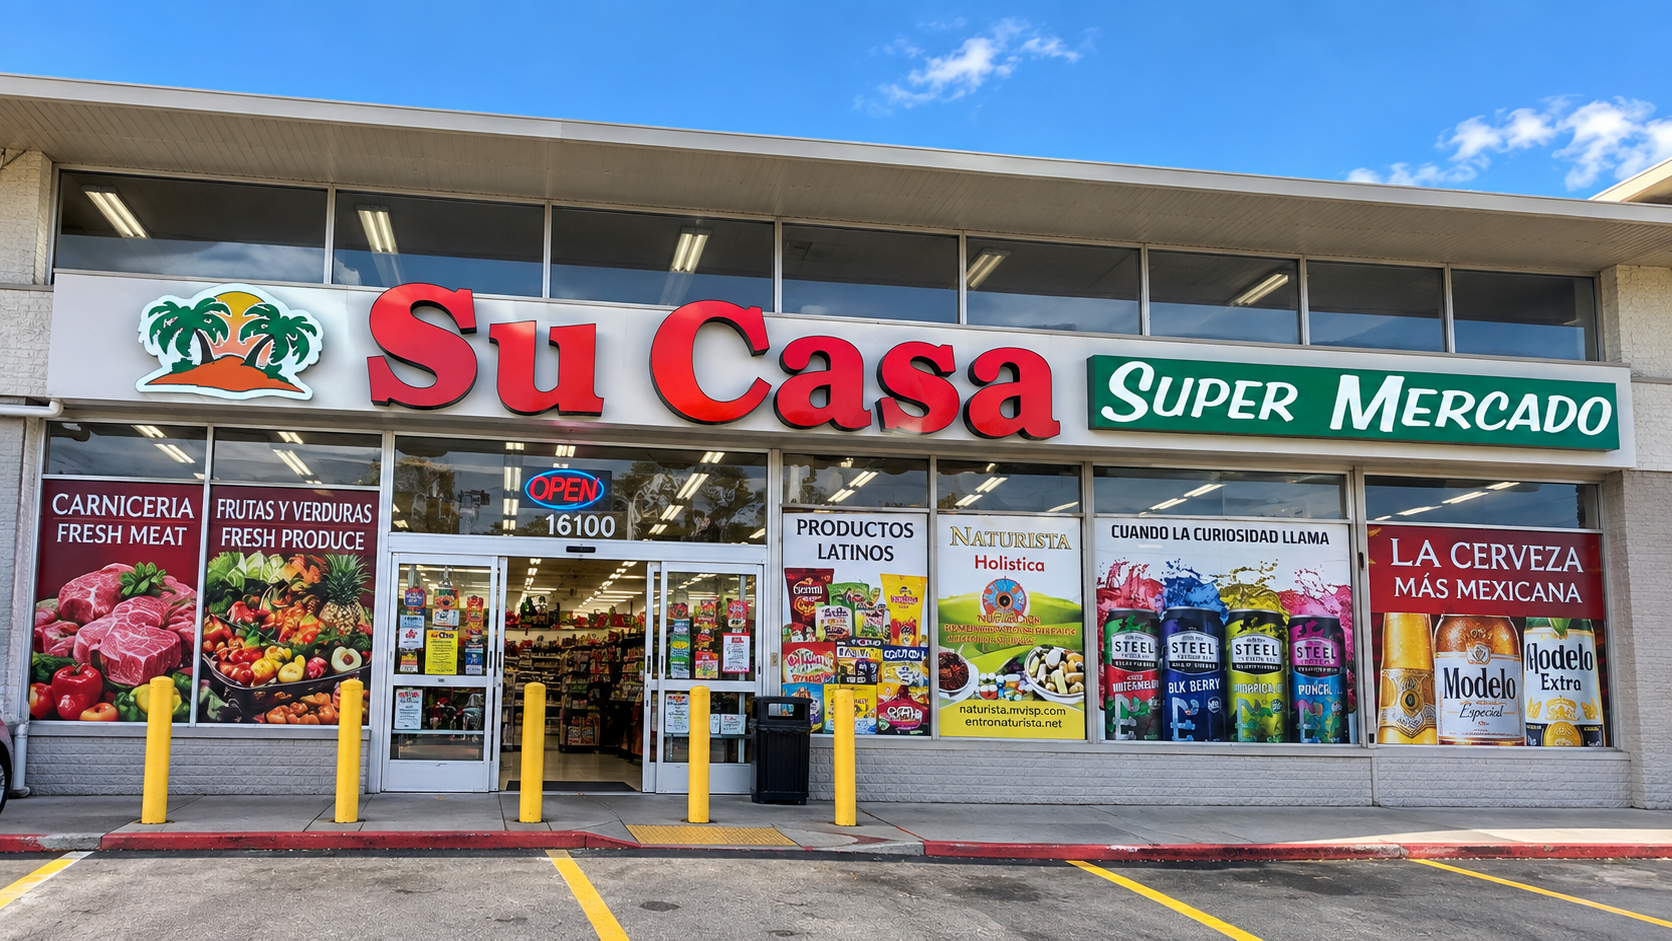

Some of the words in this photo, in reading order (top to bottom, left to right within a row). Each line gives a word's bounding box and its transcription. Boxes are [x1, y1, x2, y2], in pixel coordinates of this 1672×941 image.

[367, 281, 605, 416] Su
[649, 298, 1062, 441] Casa
[1100, 360, 1299, 424] SUPER
[1329, 374, 1613, 436] MERCADO
[529, 476, 600, 502] OPEN
[52, 493, 195, 519] CARNICERIA
[216, 498, 274, 521] FRUTAS
[278, 500, 291, 521] Y
[293, 501, 373, 525] VERDURAS
[56, 522, 123, 545] FRESH
[129, 525, 188, 546] MEAT
[545, 513, 616, 538] 16100
[796, 518, 914, 539] PRODUCTOS
[1111, 524, 1169, 540] CUANDO
[1172, 526, 1191, 541] LA
[1193, 527, 1279, 543] CURIOSIDAD
[1282, 530, 1330, 545] LLAMA
[220, 526, 276, 549] FRESH
[281, 529, 365, 551] PRODUCE
[949, 525, 1072, 551] NATURISTA
[817, 543, 895, 562] LATINOS
[974, 555, 1046, 573] Holistica
[1390, 538, 1442, 568] LA
[1450, 542, 1584, 574] CERVEZA
[1394, 572, 1449, 599] MÁS
[1456, 579, 1583, 604] MEXICANA
[1115, 641, 1154, 654] STEEL
[1171, 642, 1215, 655] STEEL
[1235, 643, 1278, 656] STEEL
[1296, 646, 1337, 659] STEEL
[1526, 642, 1594, 674] Modelo
[1168, 680, 1187, 694] BLK
[1190, 678, 1221, 692] BERRY
[1443, 667, 1517, 701] Modelo
[1541, 673, 1582, 691] Extra
[964, 717, 1062, 729] entronaturista.net
[1458, 702, 1504, 722] Especial
